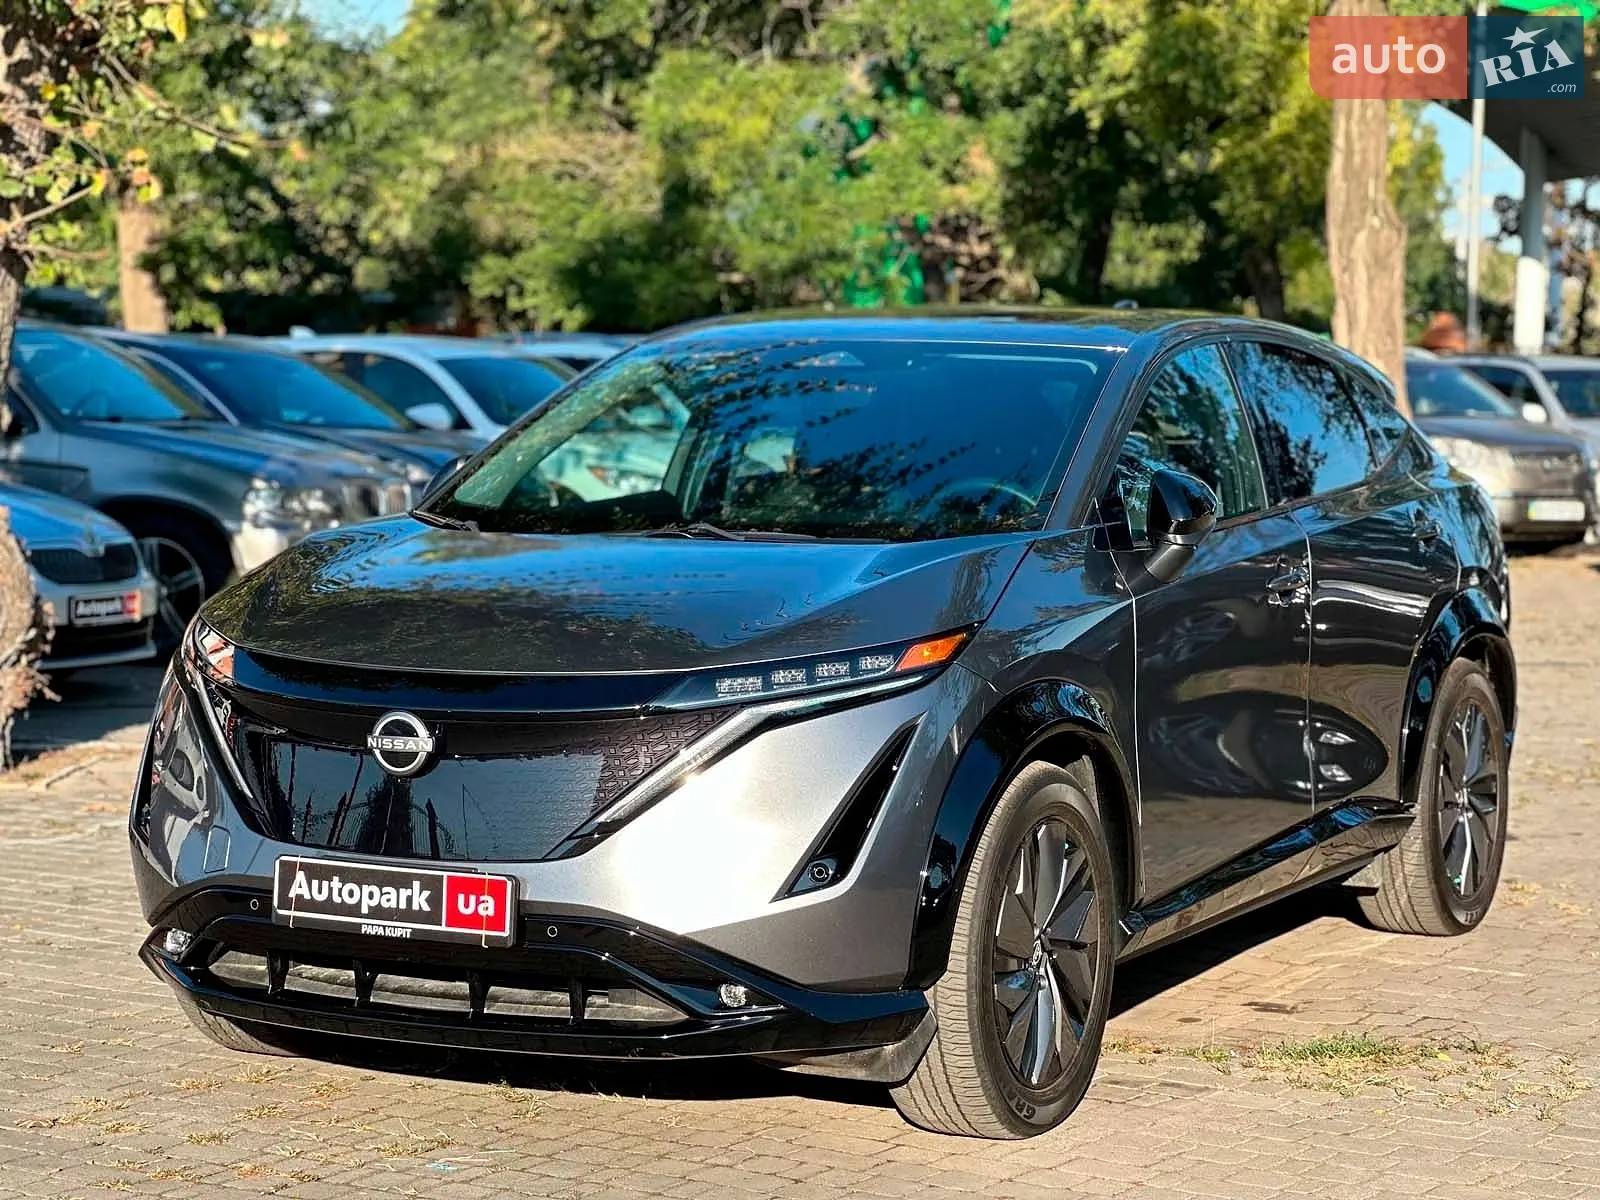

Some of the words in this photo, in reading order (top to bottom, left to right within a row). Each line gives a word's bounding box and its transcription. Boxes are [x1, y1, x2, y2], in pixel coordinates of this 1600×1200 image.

[367, 737, 431, 752] NISSAN
[288, 870, 432, 914] Autopark
[457, 893, 495, 917] ua
[361, 924, 384, 936] PAPA
[385, 926, 412, 939] KUPIT
